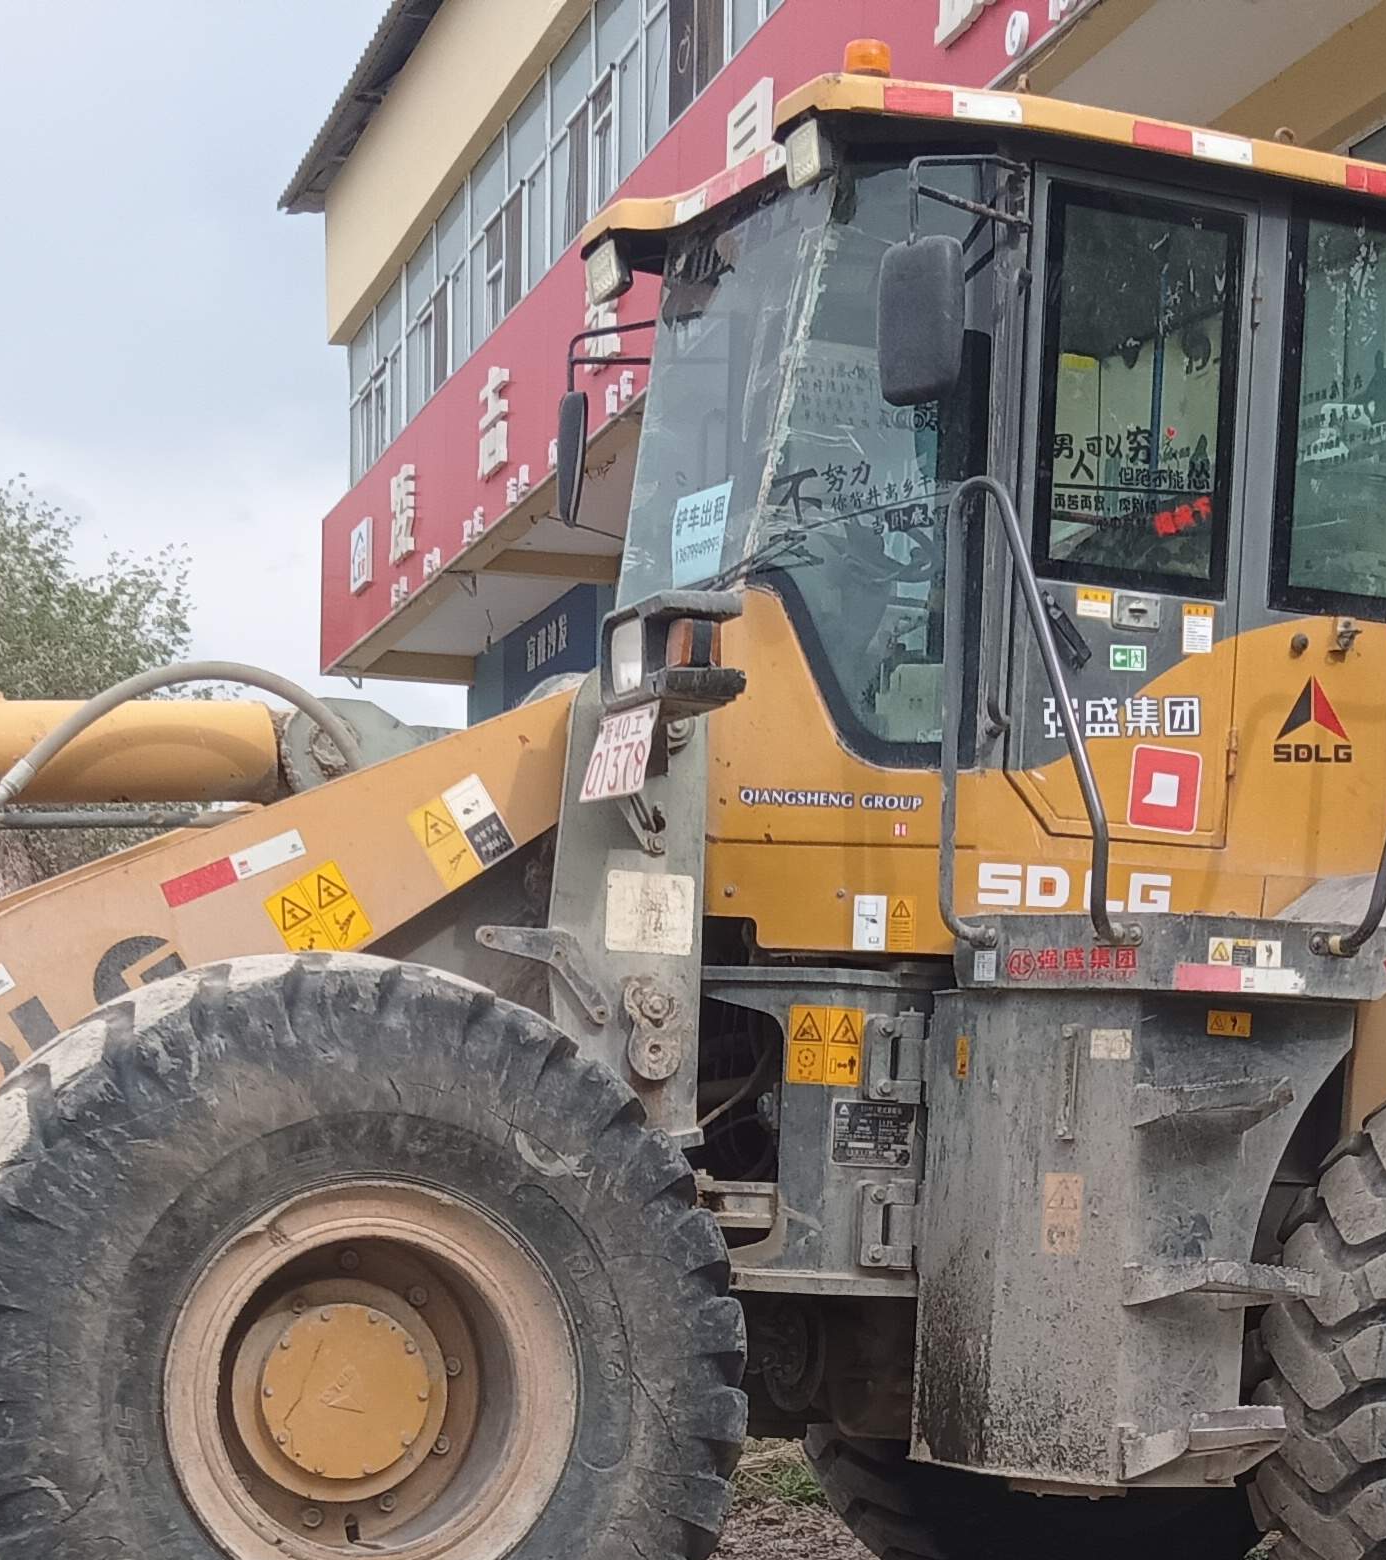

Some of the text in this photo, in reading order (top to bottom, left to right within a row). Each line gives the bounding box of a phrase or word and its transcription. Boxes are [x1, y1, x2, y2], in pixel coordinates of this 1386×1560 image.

[1043, 696, 1201, 738] 强盛集团
[585, 739, 646, 796] 01378
[1273, 744, 1353, 763] SDLG
[740, 788, 924, 812] QIANGSHENG GROUP
